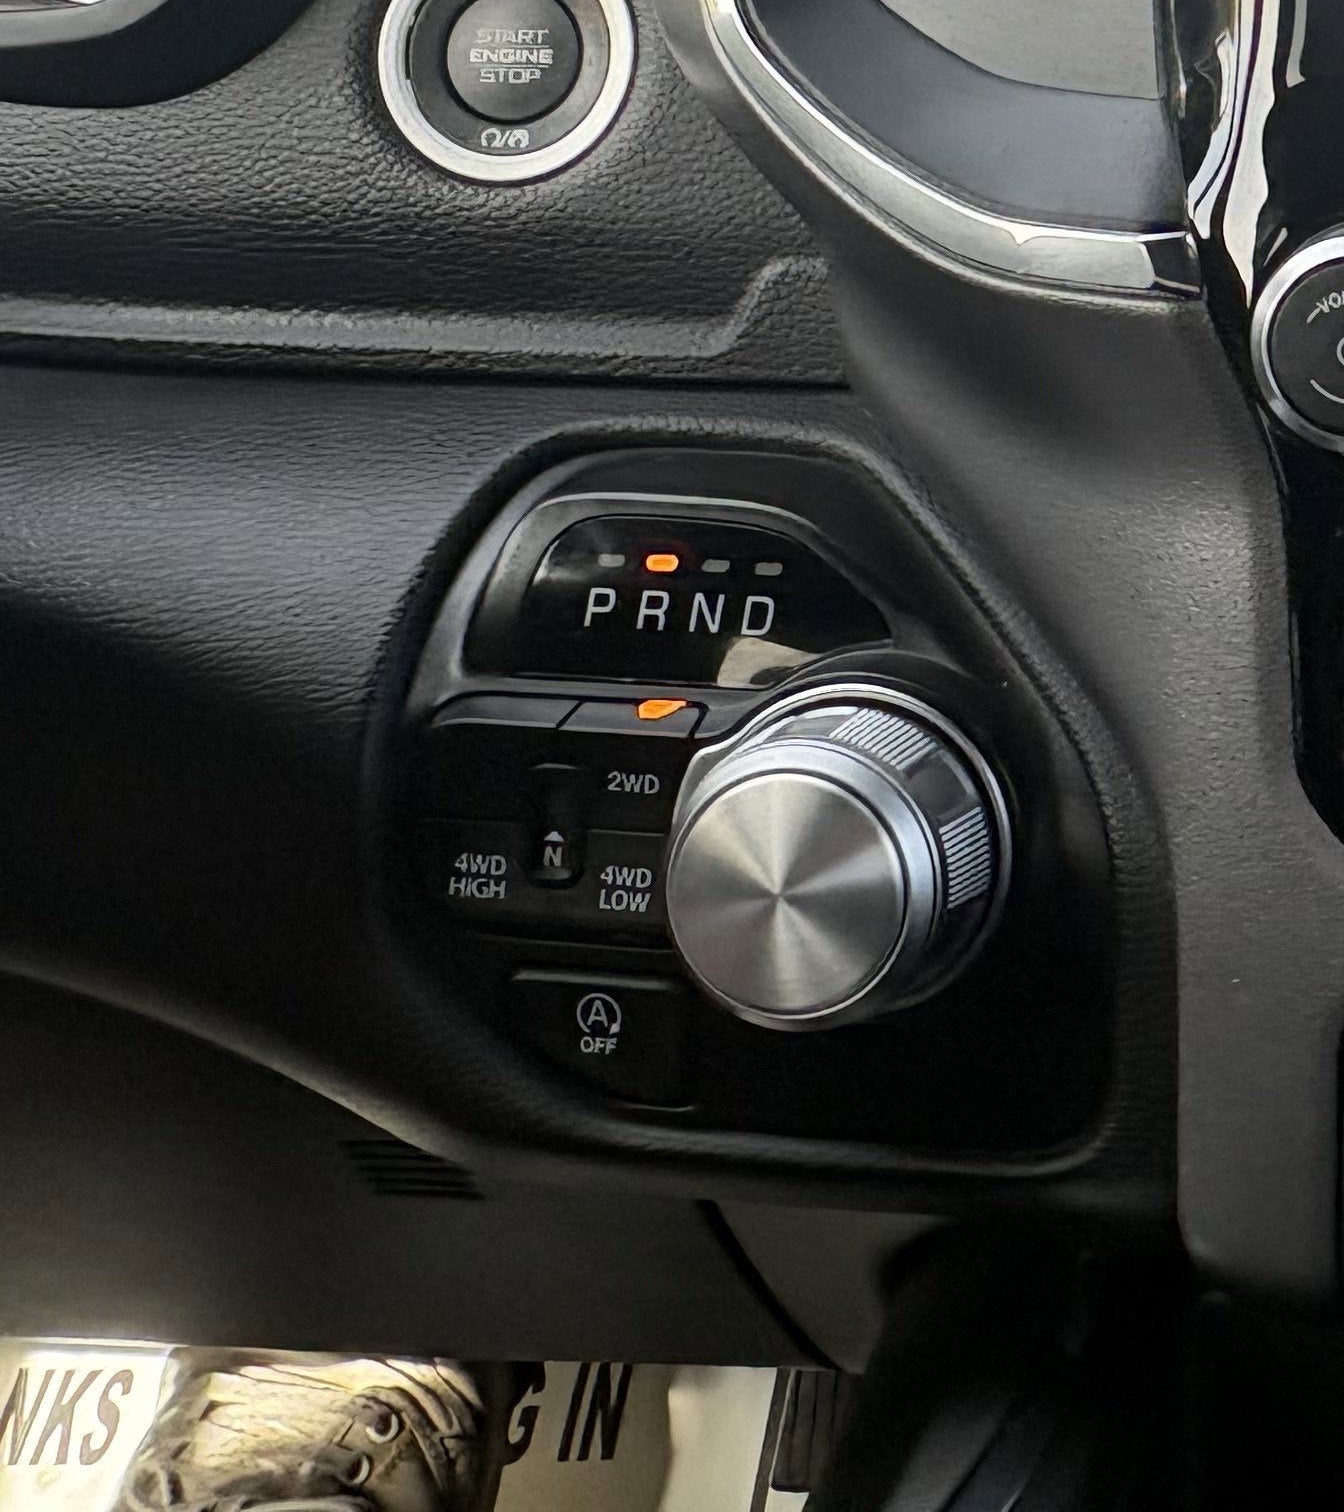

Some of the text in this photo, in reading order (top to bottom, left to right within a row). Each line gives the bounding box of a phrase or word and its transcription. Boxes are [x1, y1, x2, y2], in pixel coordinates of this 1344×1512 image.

[474, 29, 550, 44] START
[469, 48, 554, 65] ENGINE
[480, 68, 541, 84] STOP
[583, 587, 775, 637] P R N D
[607, 770, 660, 795] 2WD
[454, 852, 507, 876] 4WD
[543, 845, 563, 868] N
[448, 876, 507, 900] HIGH
[599, 865, 652, 891] 4WD
[599, 888, 651, 913] LOW
[579, 1035, 618, 1055] OFF
